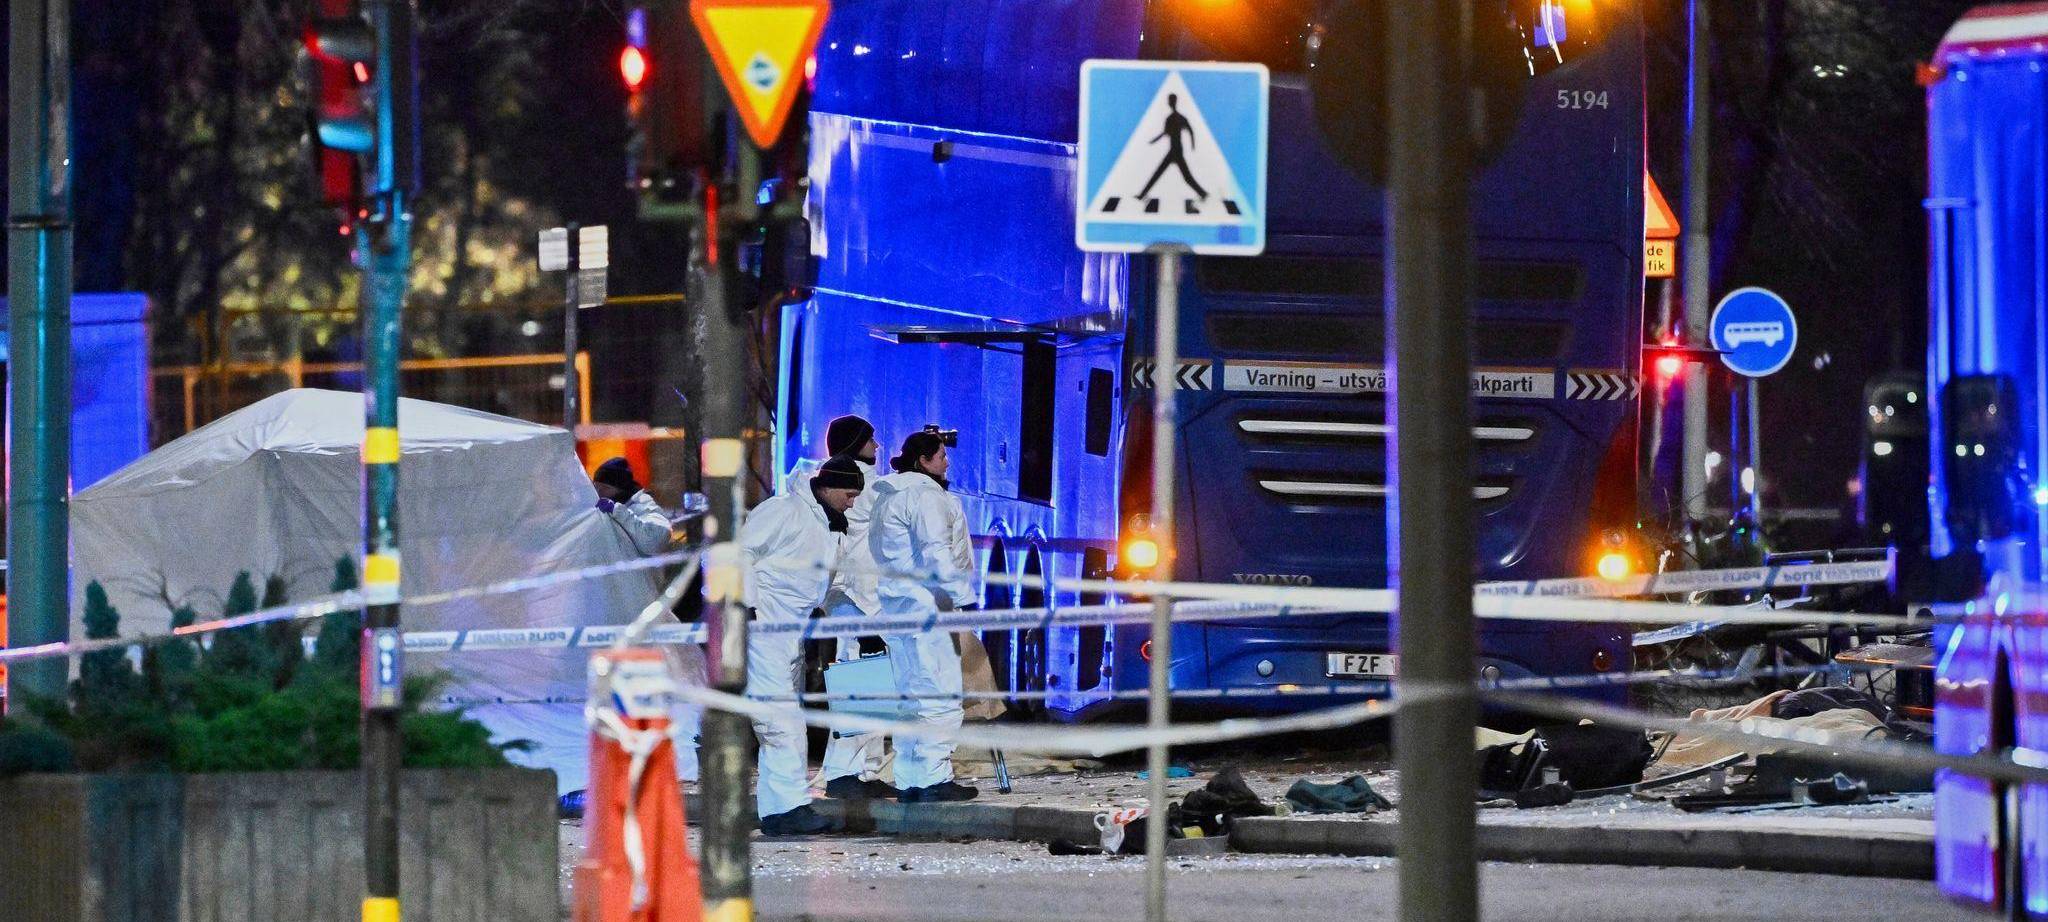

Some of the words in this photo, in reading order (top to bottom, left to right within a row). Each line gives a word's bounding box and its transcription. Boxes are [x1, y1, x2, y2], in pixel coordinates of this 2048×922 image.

[1557, 90, 1609, 109] 5194
[1646, 246, 1664, 256] de
[1647, 260, 1665, 271] fik
[1246, 369, 1316, 390] Varning
[1339, 373, 1387, 389] utsvä
[1471, 375, 1533, 394] akparti
[1232, 573, 1313, 586] VOLVO
[1344, 655, 1381, 673] FZF
